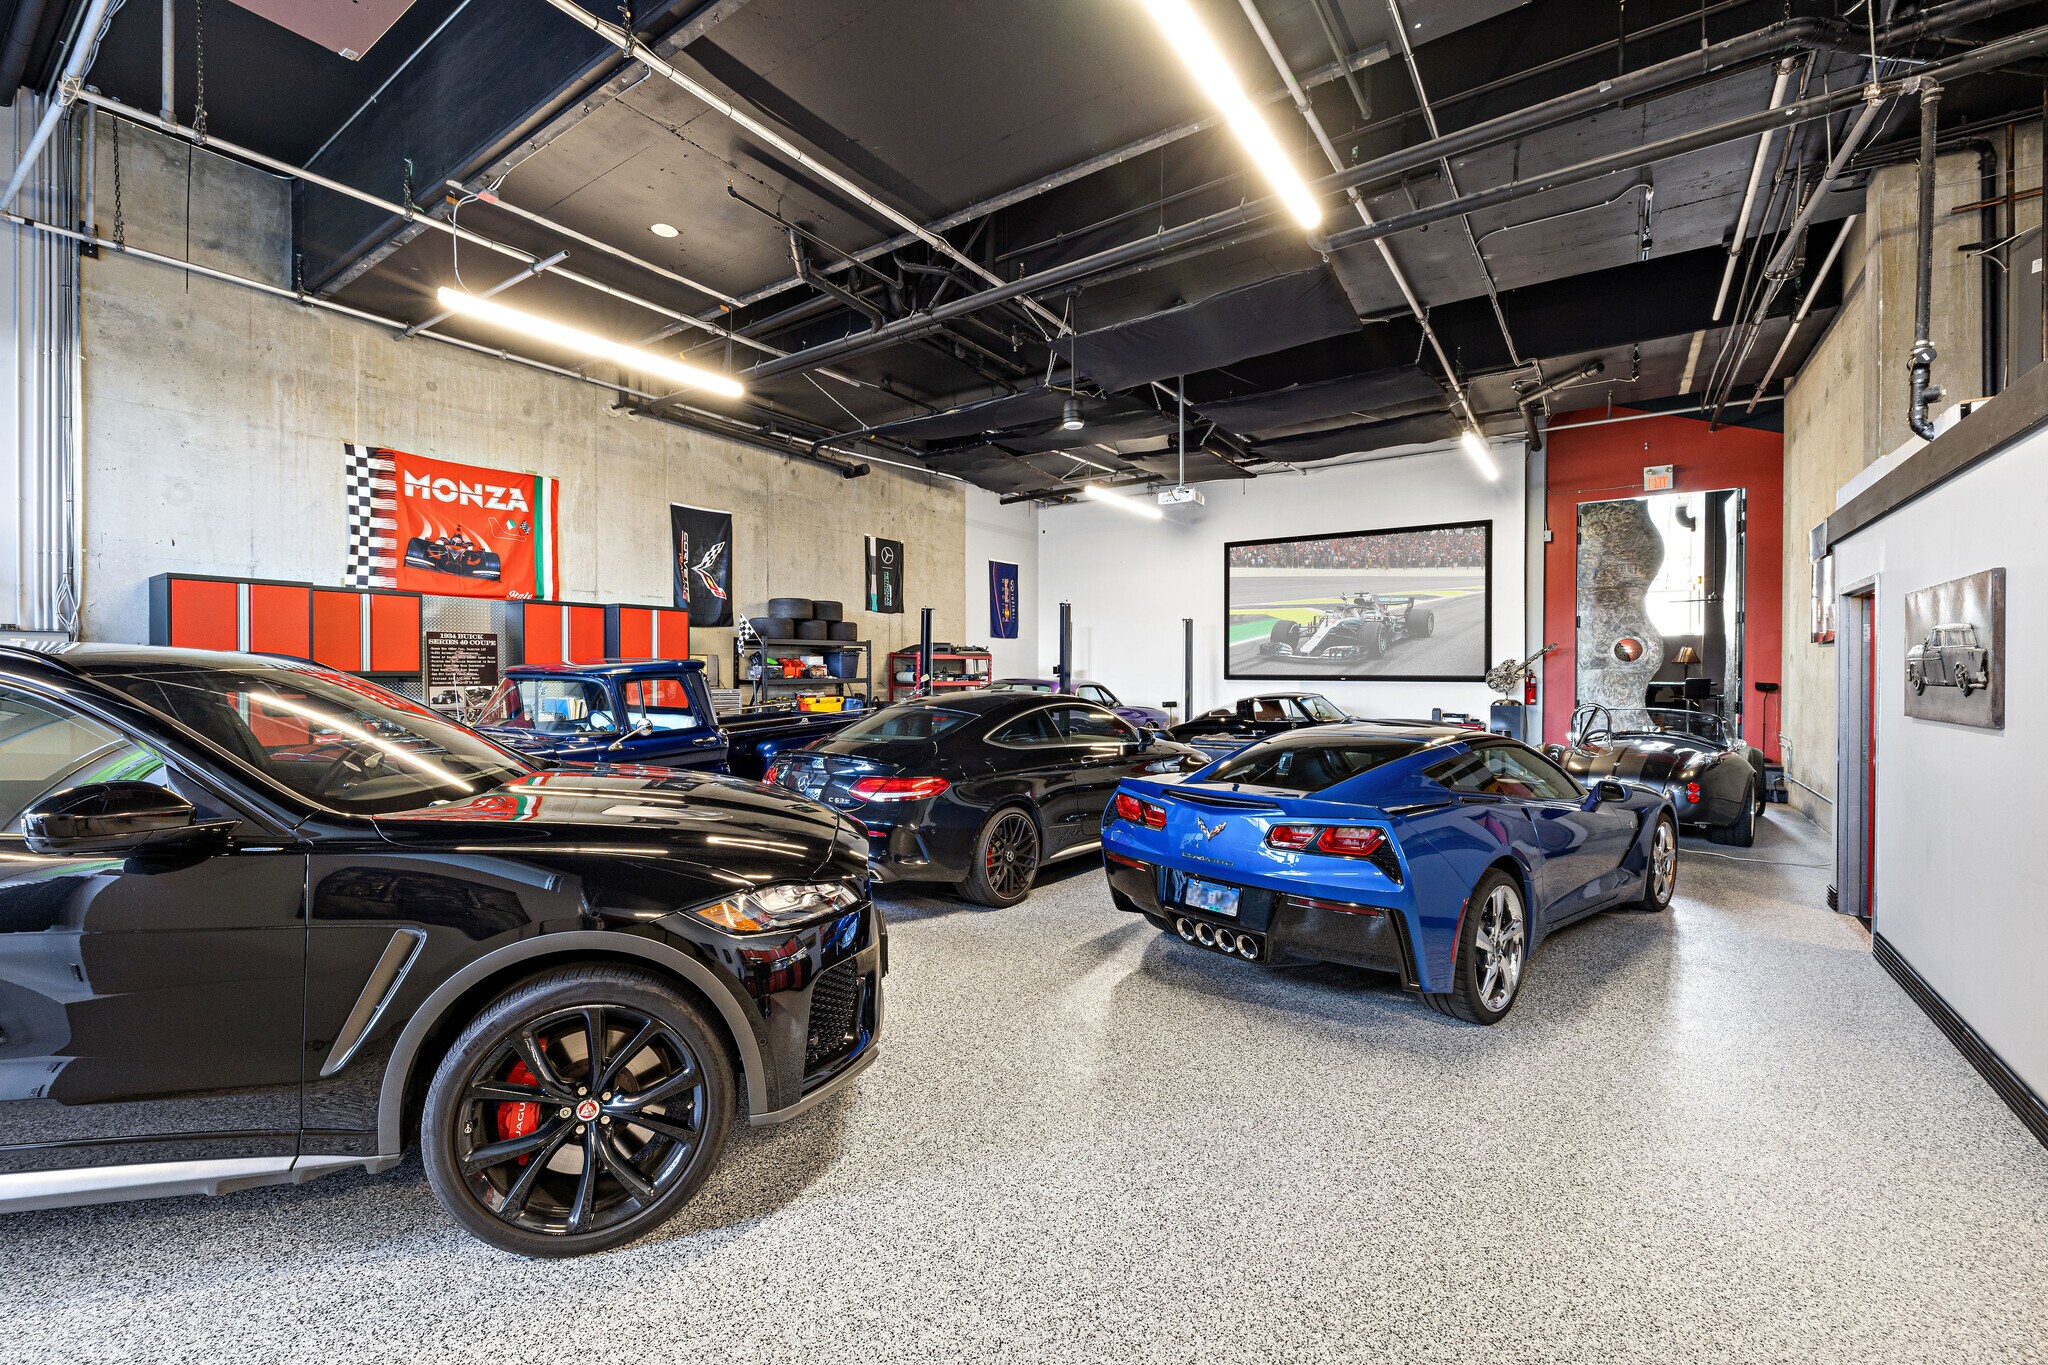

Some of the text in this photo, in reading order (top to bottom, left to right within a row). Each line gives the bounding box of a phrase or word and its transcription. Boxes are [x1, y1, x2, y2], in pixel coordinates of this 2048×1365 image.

[404, 469, 529, 512] MONZA
[1648, 475, 1668, 490] EXIT
[515, 1102, 526, 1137] JAGU
